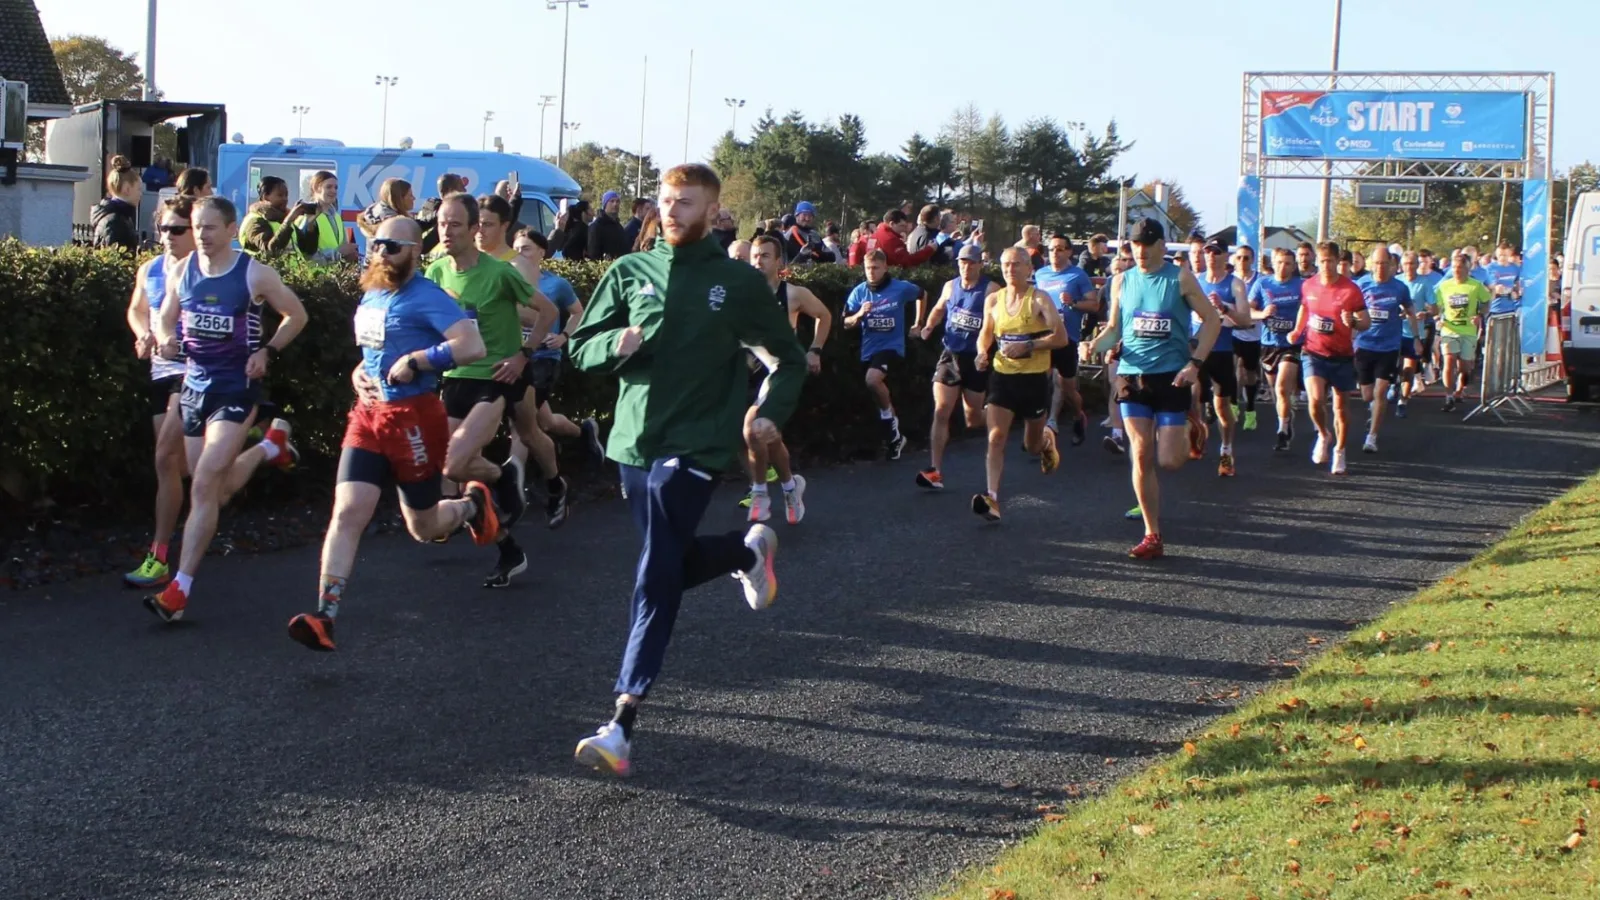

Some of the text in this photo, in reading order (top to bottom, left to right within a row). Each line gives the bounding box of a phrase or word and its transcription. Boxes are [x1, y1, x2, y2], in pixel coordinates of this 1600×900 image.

[1347, 101, 1434, 132] START
[1350, 139, 1372, 148] MSD
[1385, 189, 1420, 203] 0:00
[194, 314, 231, 331] 2564
[958, 314, 980, 327] 2583
[1140, 319, 1169, 330] 2732
